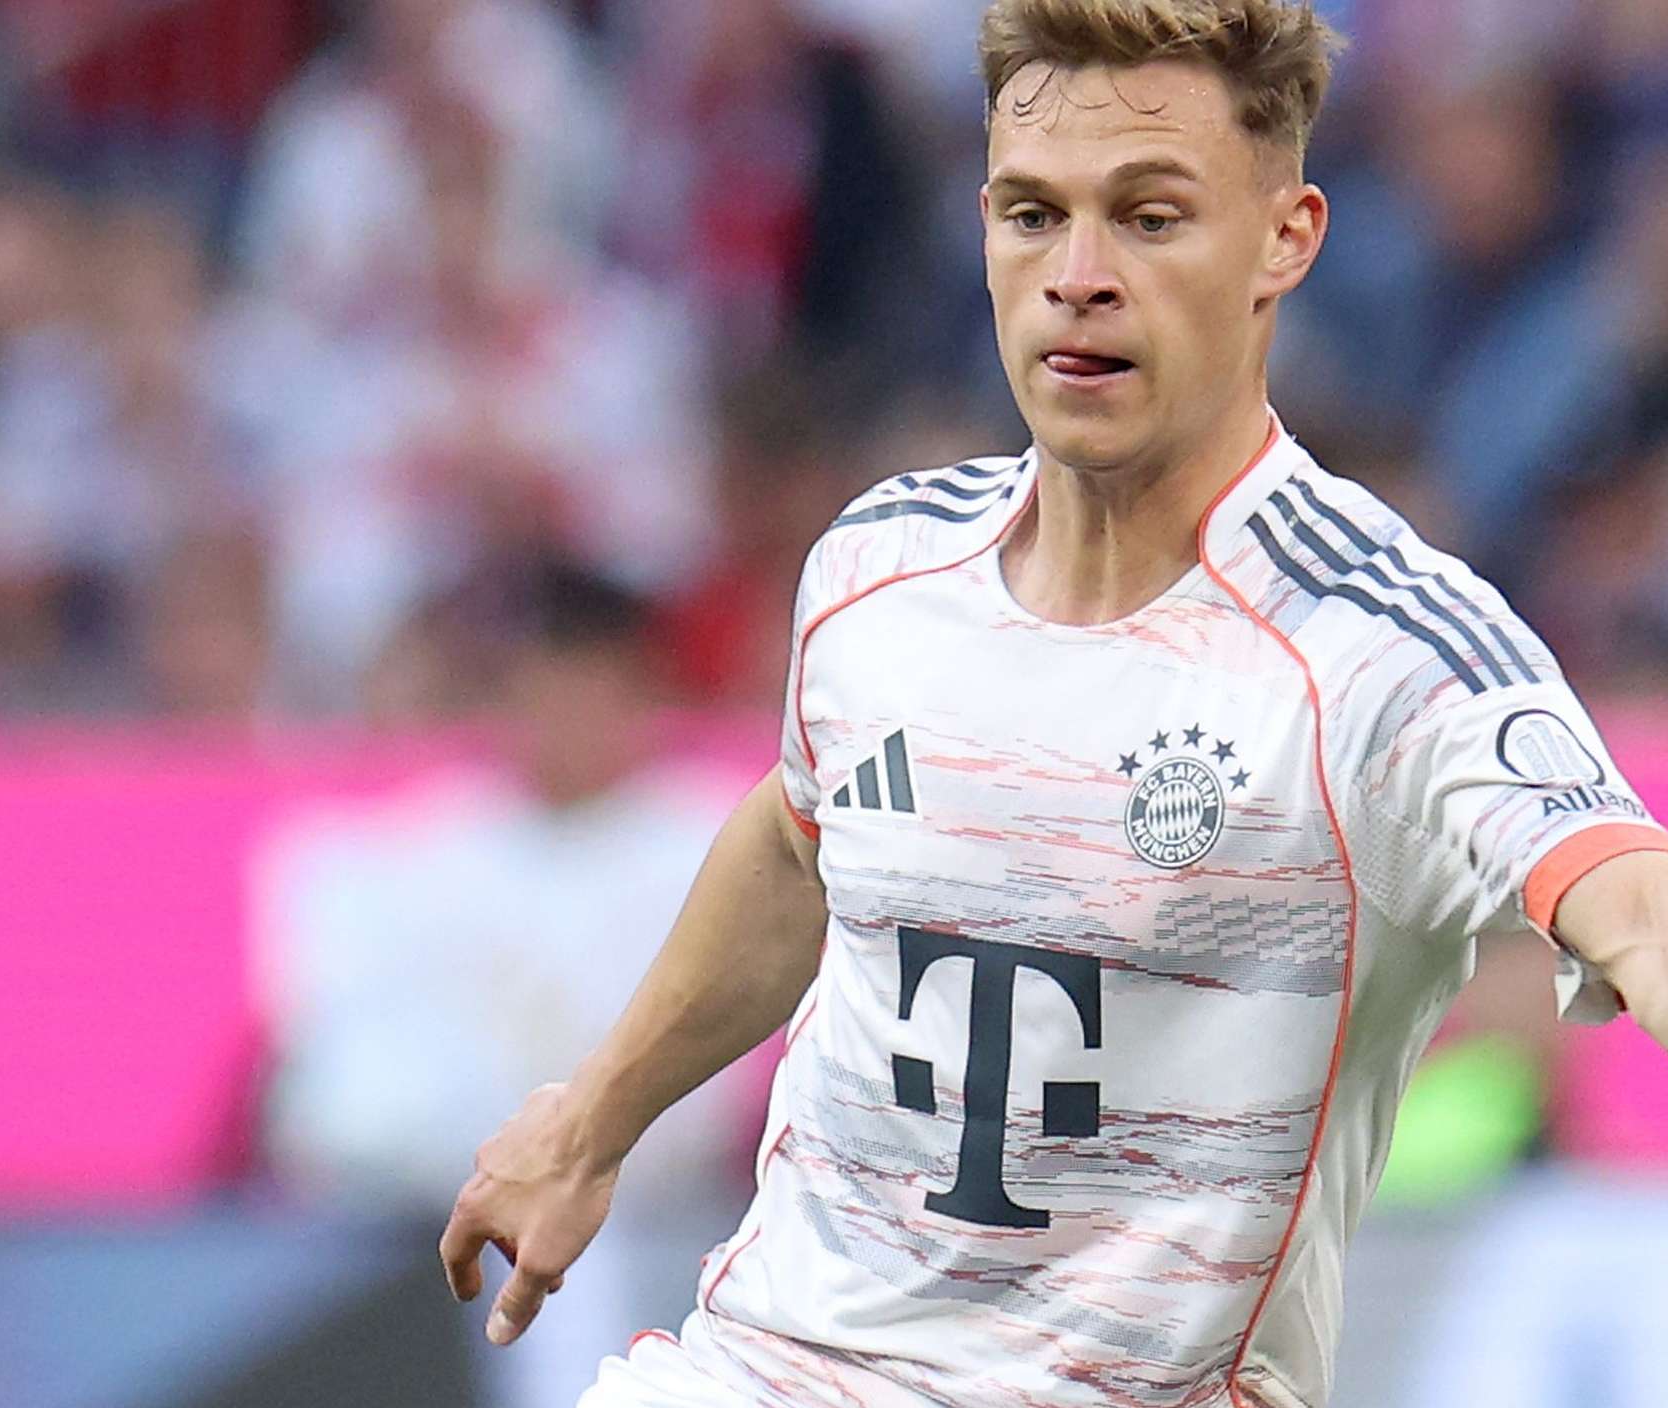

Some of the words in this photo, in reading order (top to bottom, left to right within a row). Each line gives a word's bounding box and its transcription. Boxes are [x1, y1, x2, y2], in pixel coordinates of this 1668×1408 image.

[1138, 775, 1159, 801] FC
[1162, 765, 1217, 808] BAYERN
[891, 925, 1102, 1229] T
